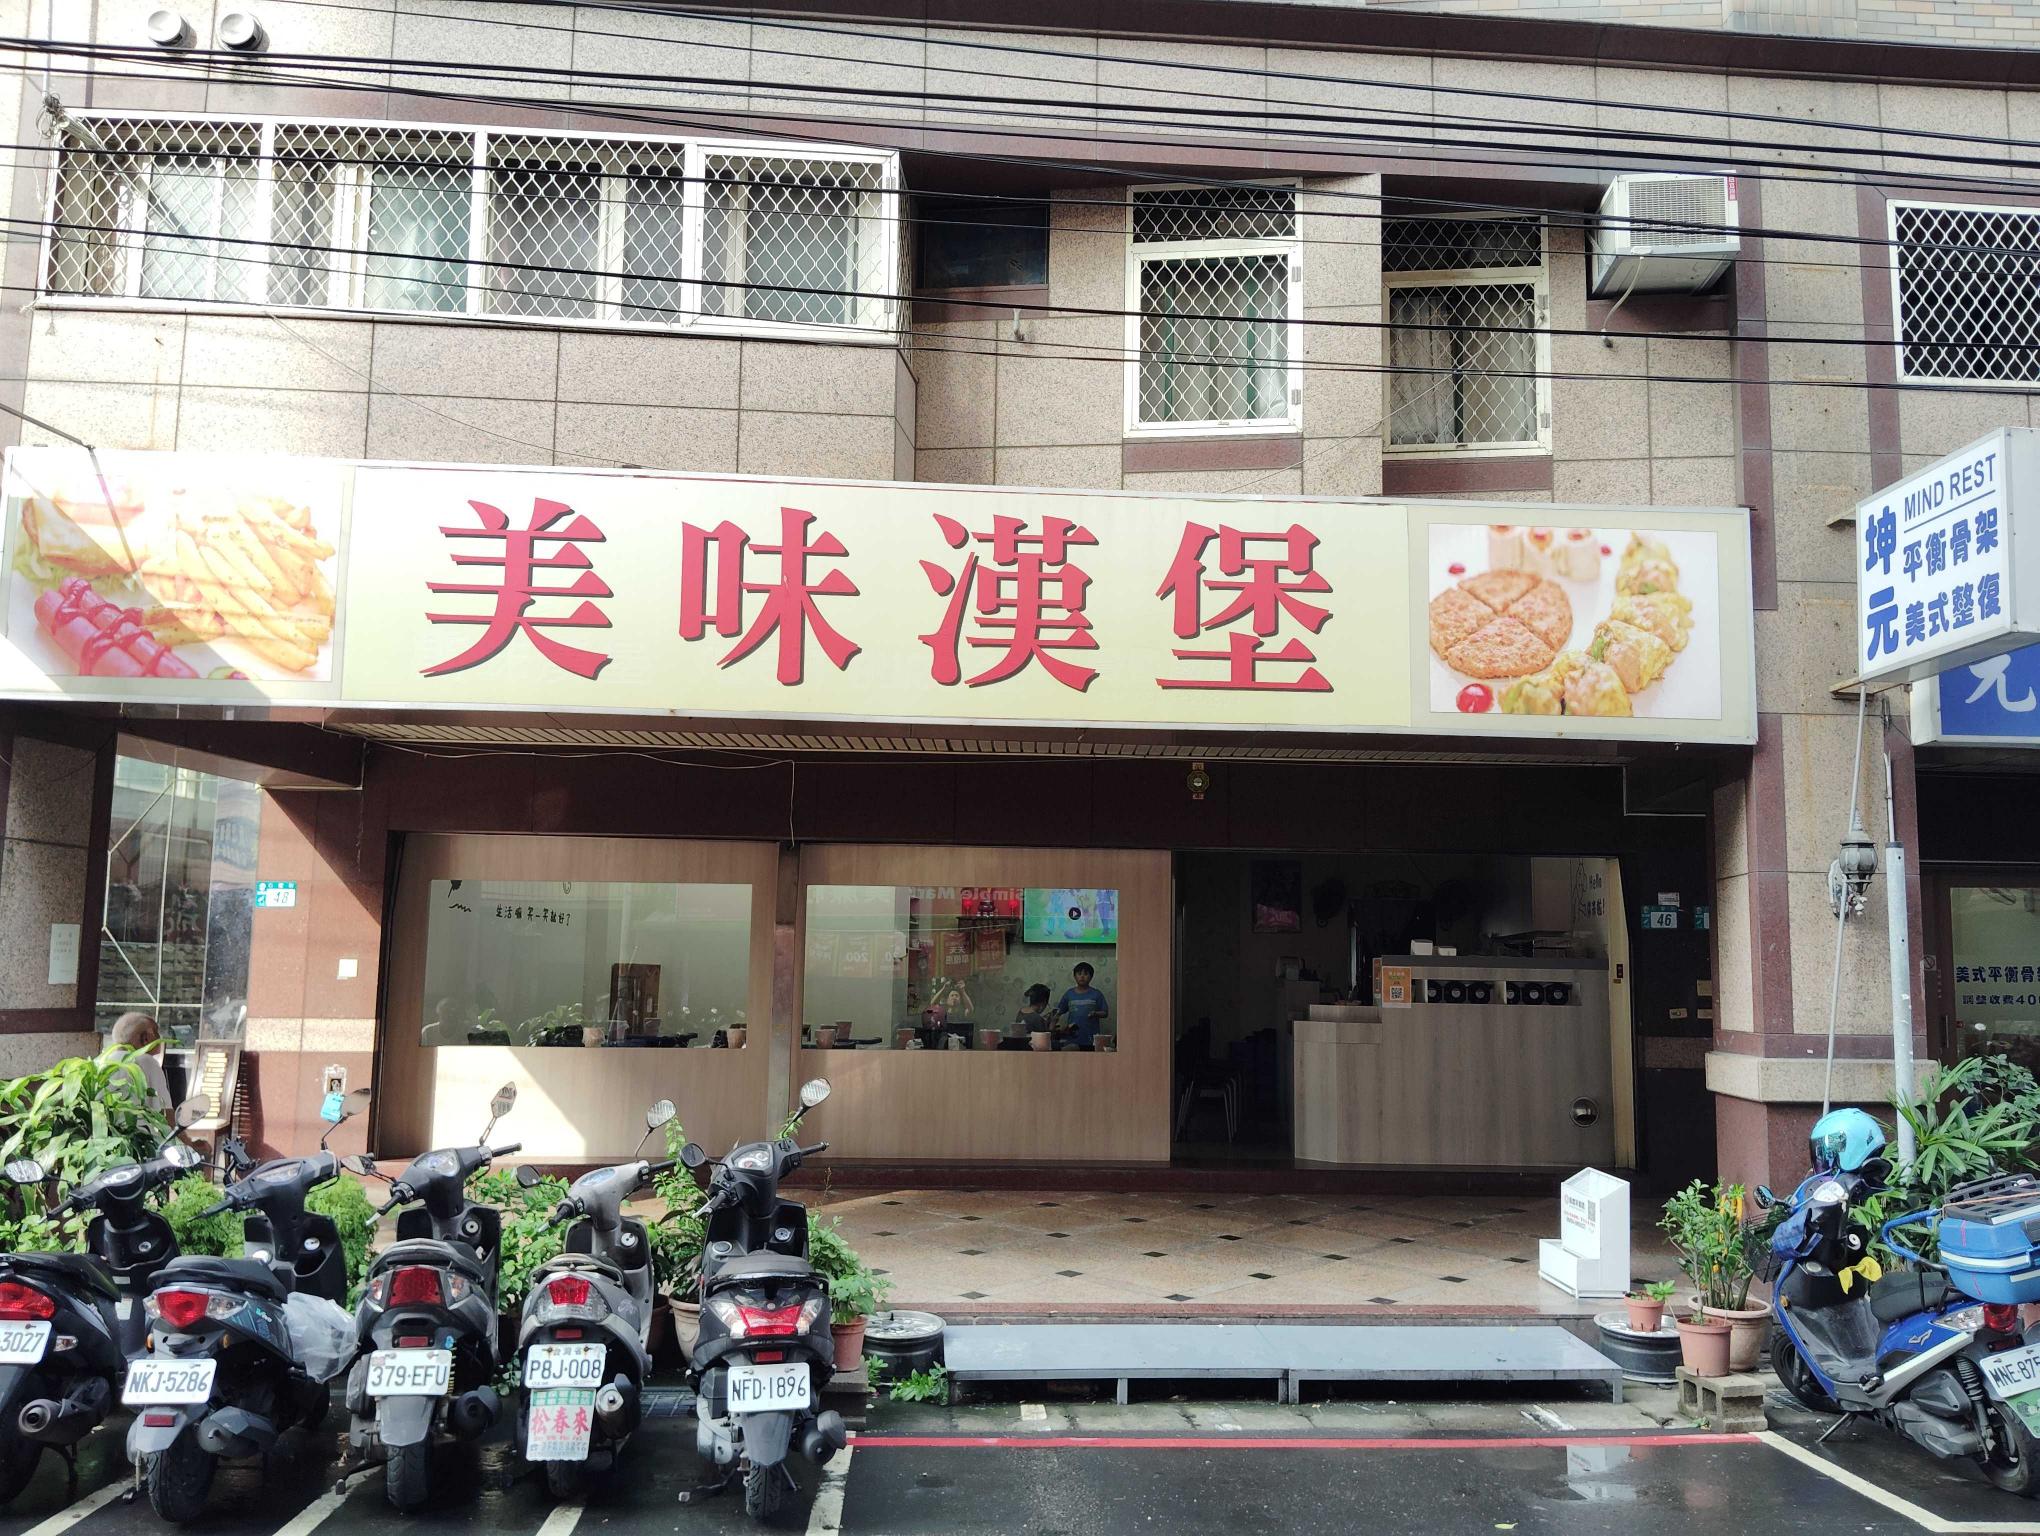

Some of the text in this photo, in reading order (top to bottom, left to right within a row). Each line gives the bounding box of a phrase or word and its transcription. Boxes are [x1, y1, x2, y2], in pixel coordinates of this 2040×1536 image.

[1903, 453, 1996, 522] MIND REST
[1903, 507, 1998, 583] 平衡骨架
[419, 496, 1335, 695] 美味漢堡
[1905, 572, 2001, 646] 美式整復
[1656, 913, 1672, 927] 46
[1962, 994, 2040, 1005] 調整收費40
